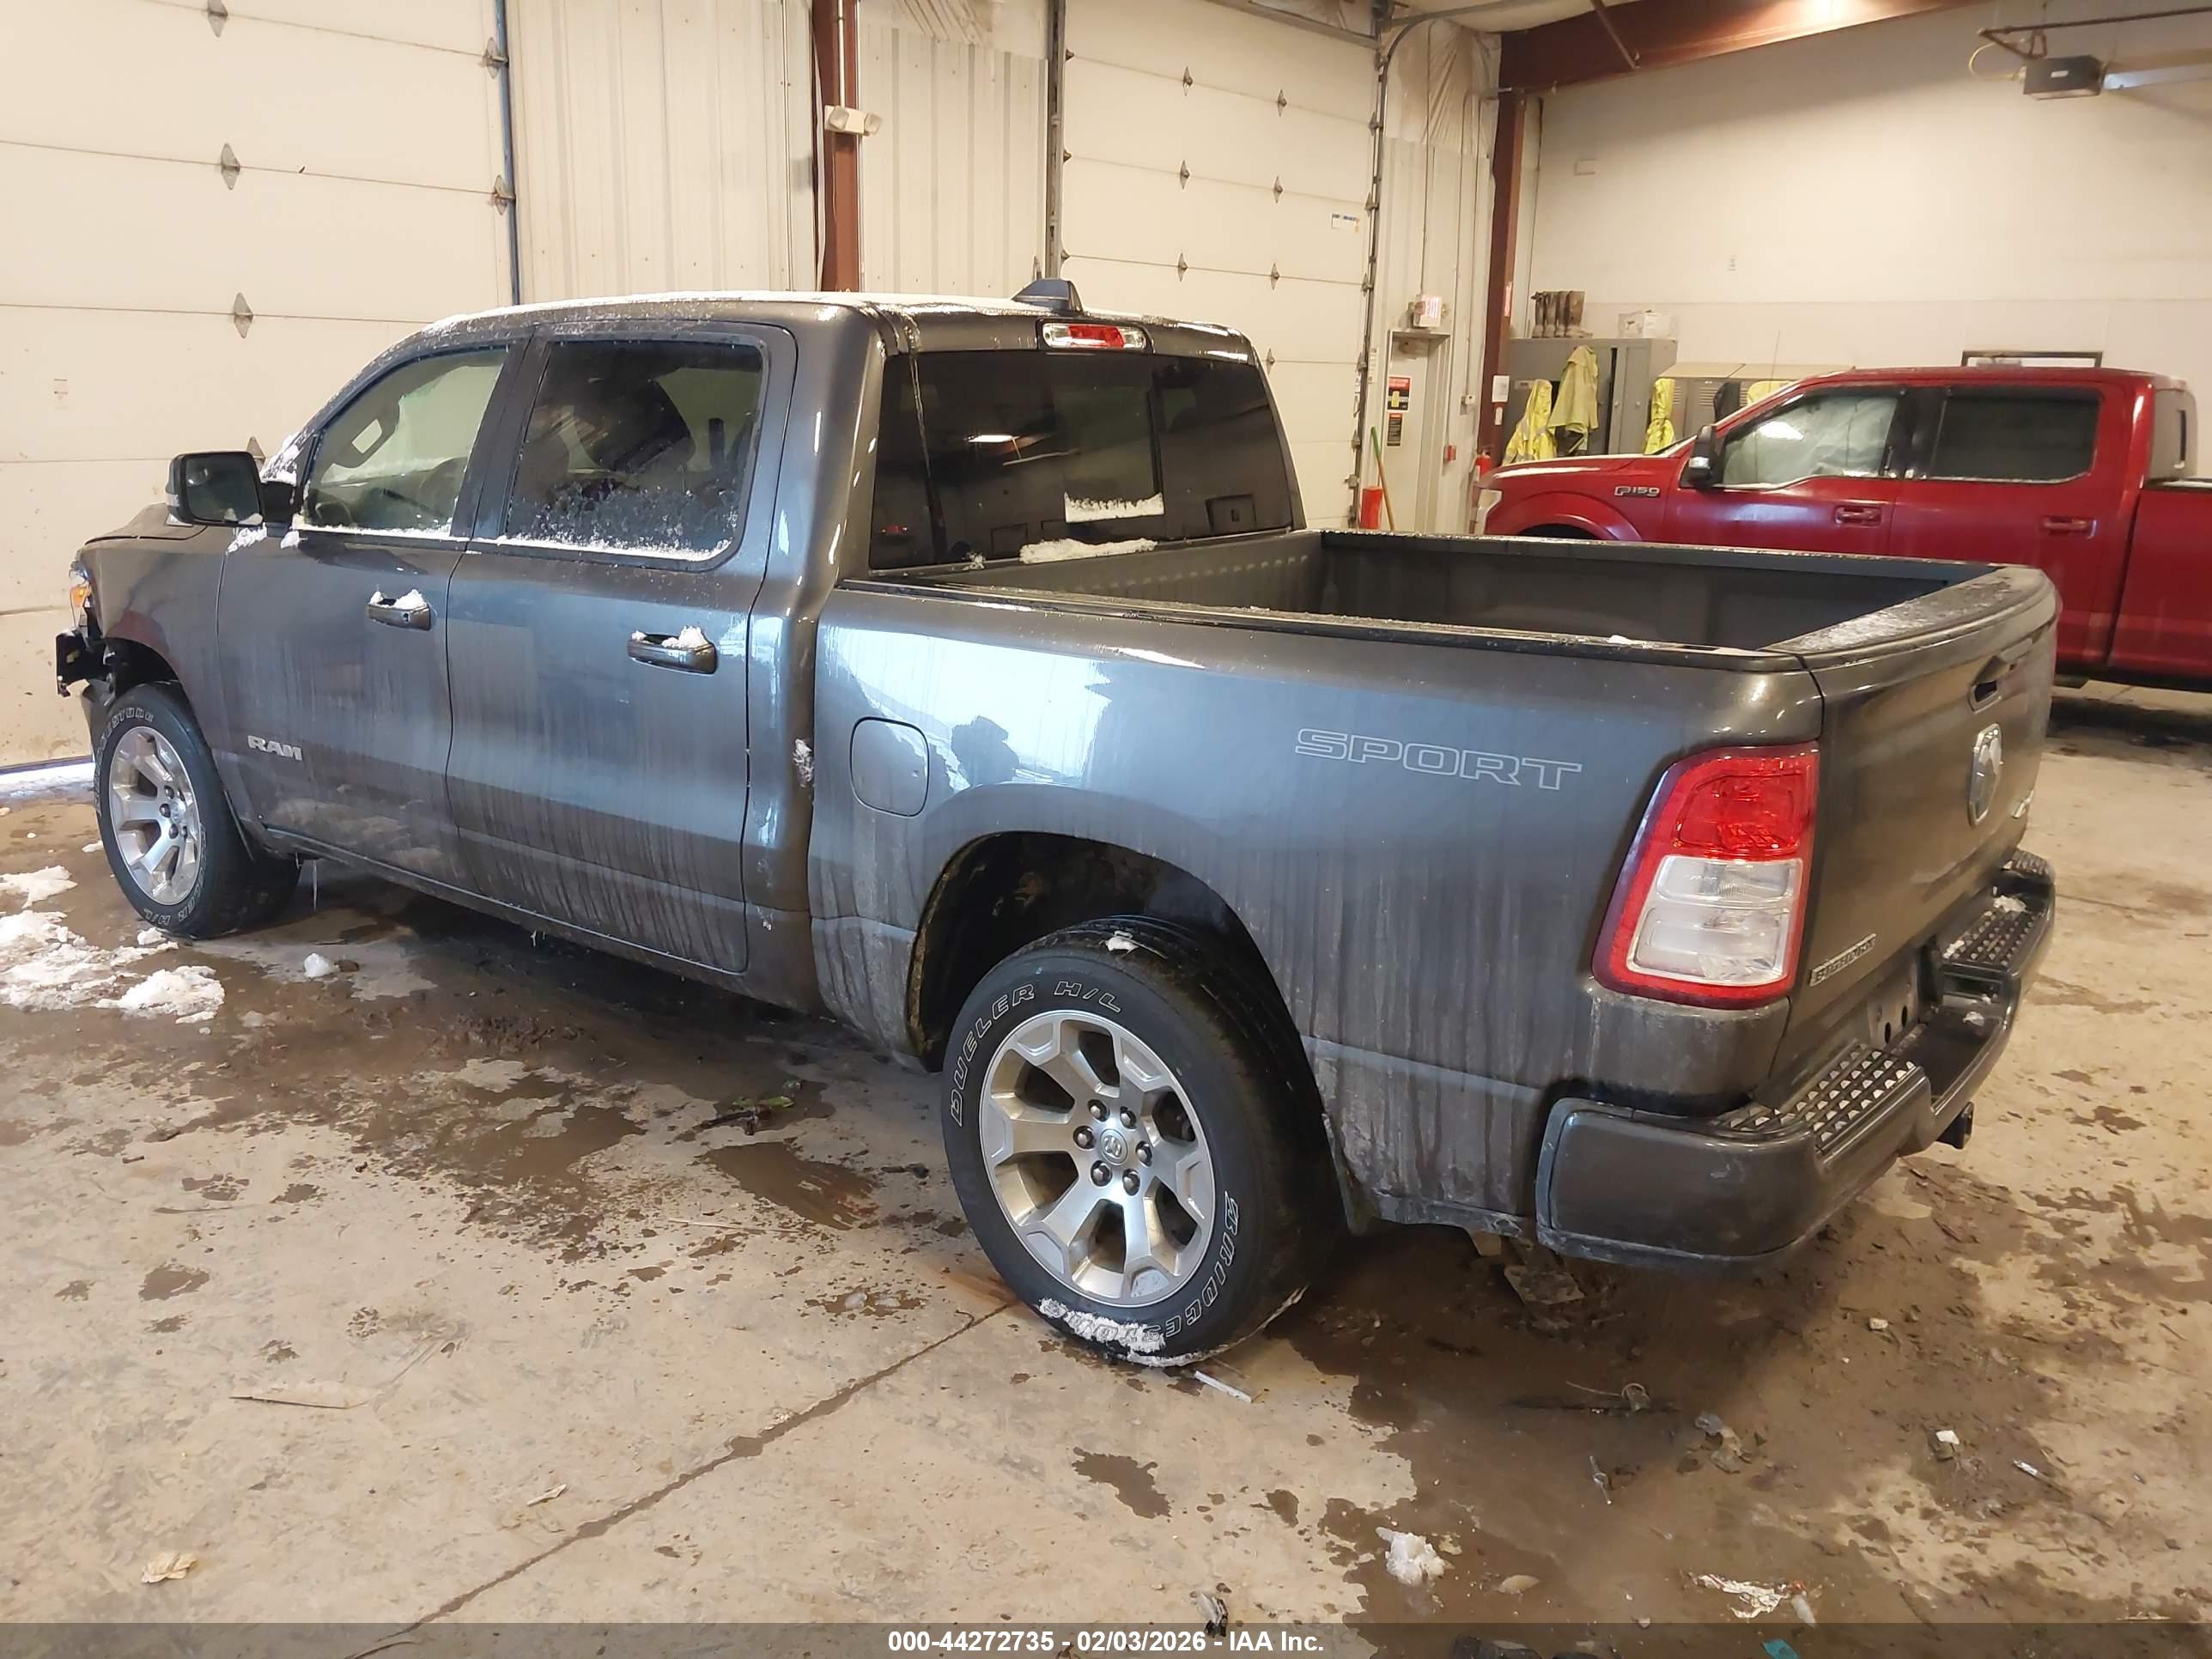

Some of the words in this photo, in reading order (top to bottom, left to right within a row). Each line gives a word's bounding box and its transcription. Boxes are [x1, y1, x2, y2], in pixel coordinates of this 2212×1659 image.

[247, 735, 303, 761] RAM
[1295, 728, 1583, 791] SPORT
[951, 984, 1035, 1127] DUELER
[1054, 981, 1121, 1013] H/L
